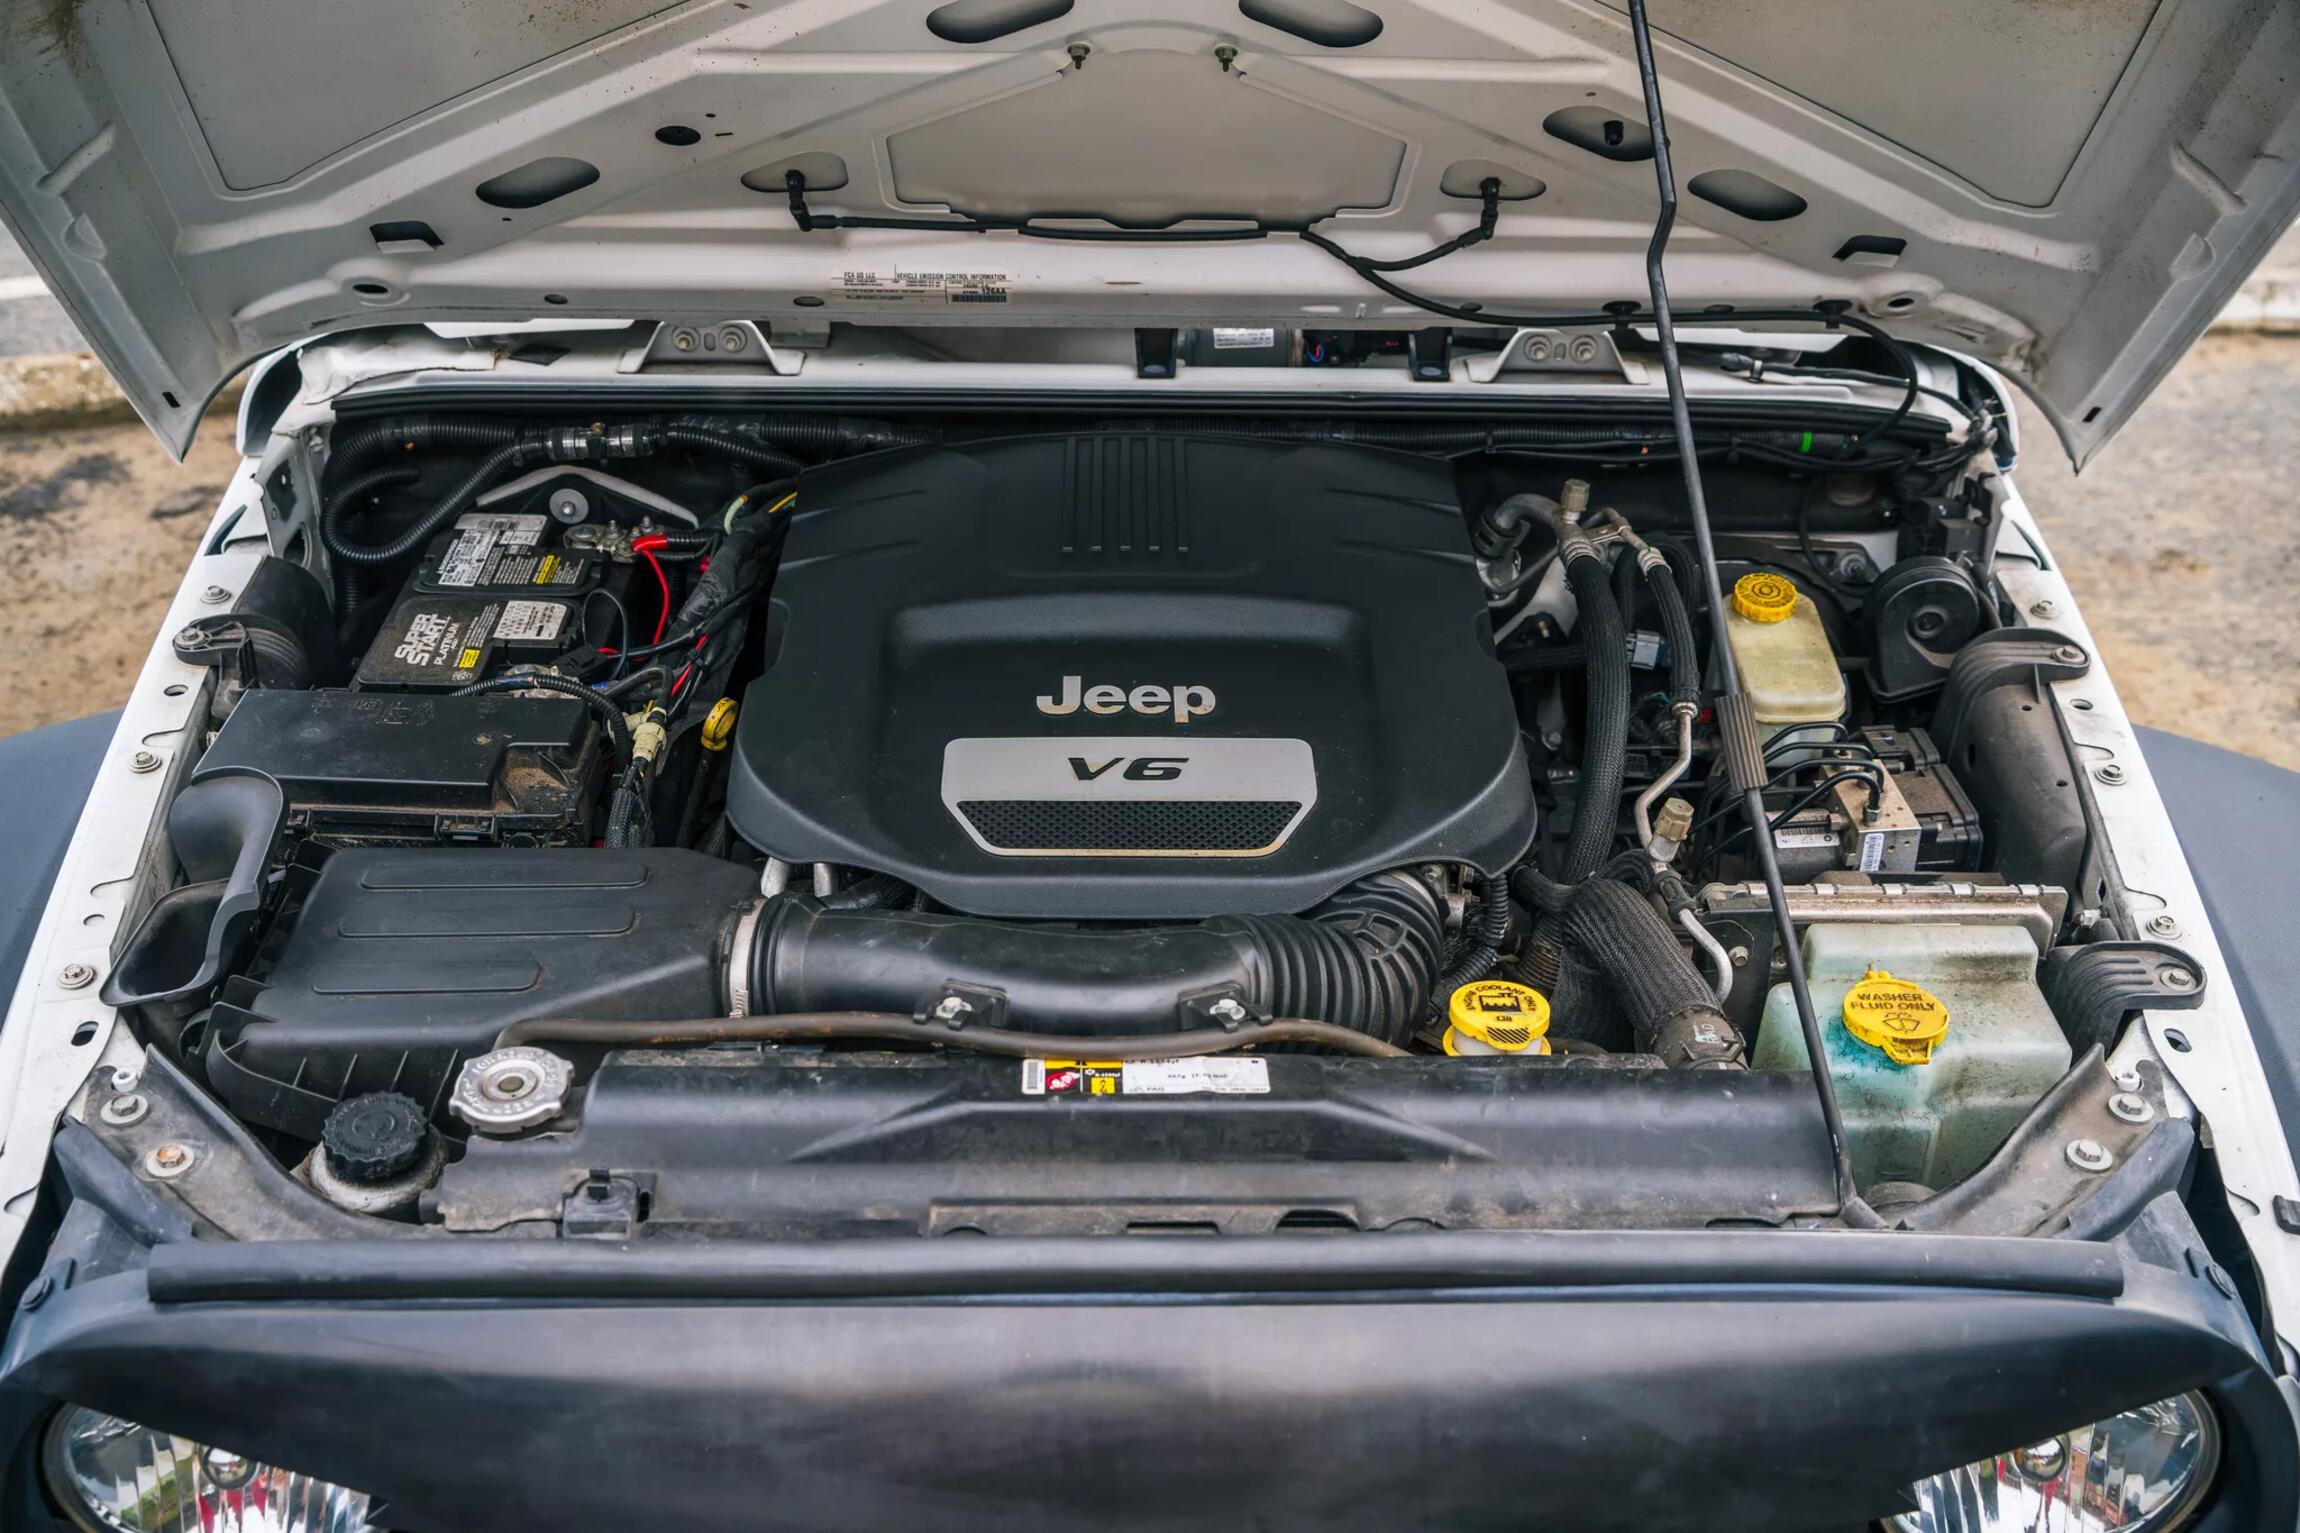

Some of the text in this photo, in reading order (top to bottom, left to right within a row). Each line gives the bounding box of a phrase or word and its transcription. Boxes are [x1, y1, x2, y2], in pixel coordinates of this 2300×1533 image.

[945, 273, 969, 281] CONTROL
[394, 613, 432, 659] SUPER
[406, 613, 447, 666] START
[433, 622, 460, 665] PLATINUM
[1036, 675, 1216, 723] Jeep
[1068, 757, 1190, 781] V6
[1475, 984, 1526, 995] COOLANT
[1523, 995, 1537, 1012] ONLY
[1850, 1001, 1935, 1011] FLUID ONLY
[1857, 993, 1924, 1001] WASHER
